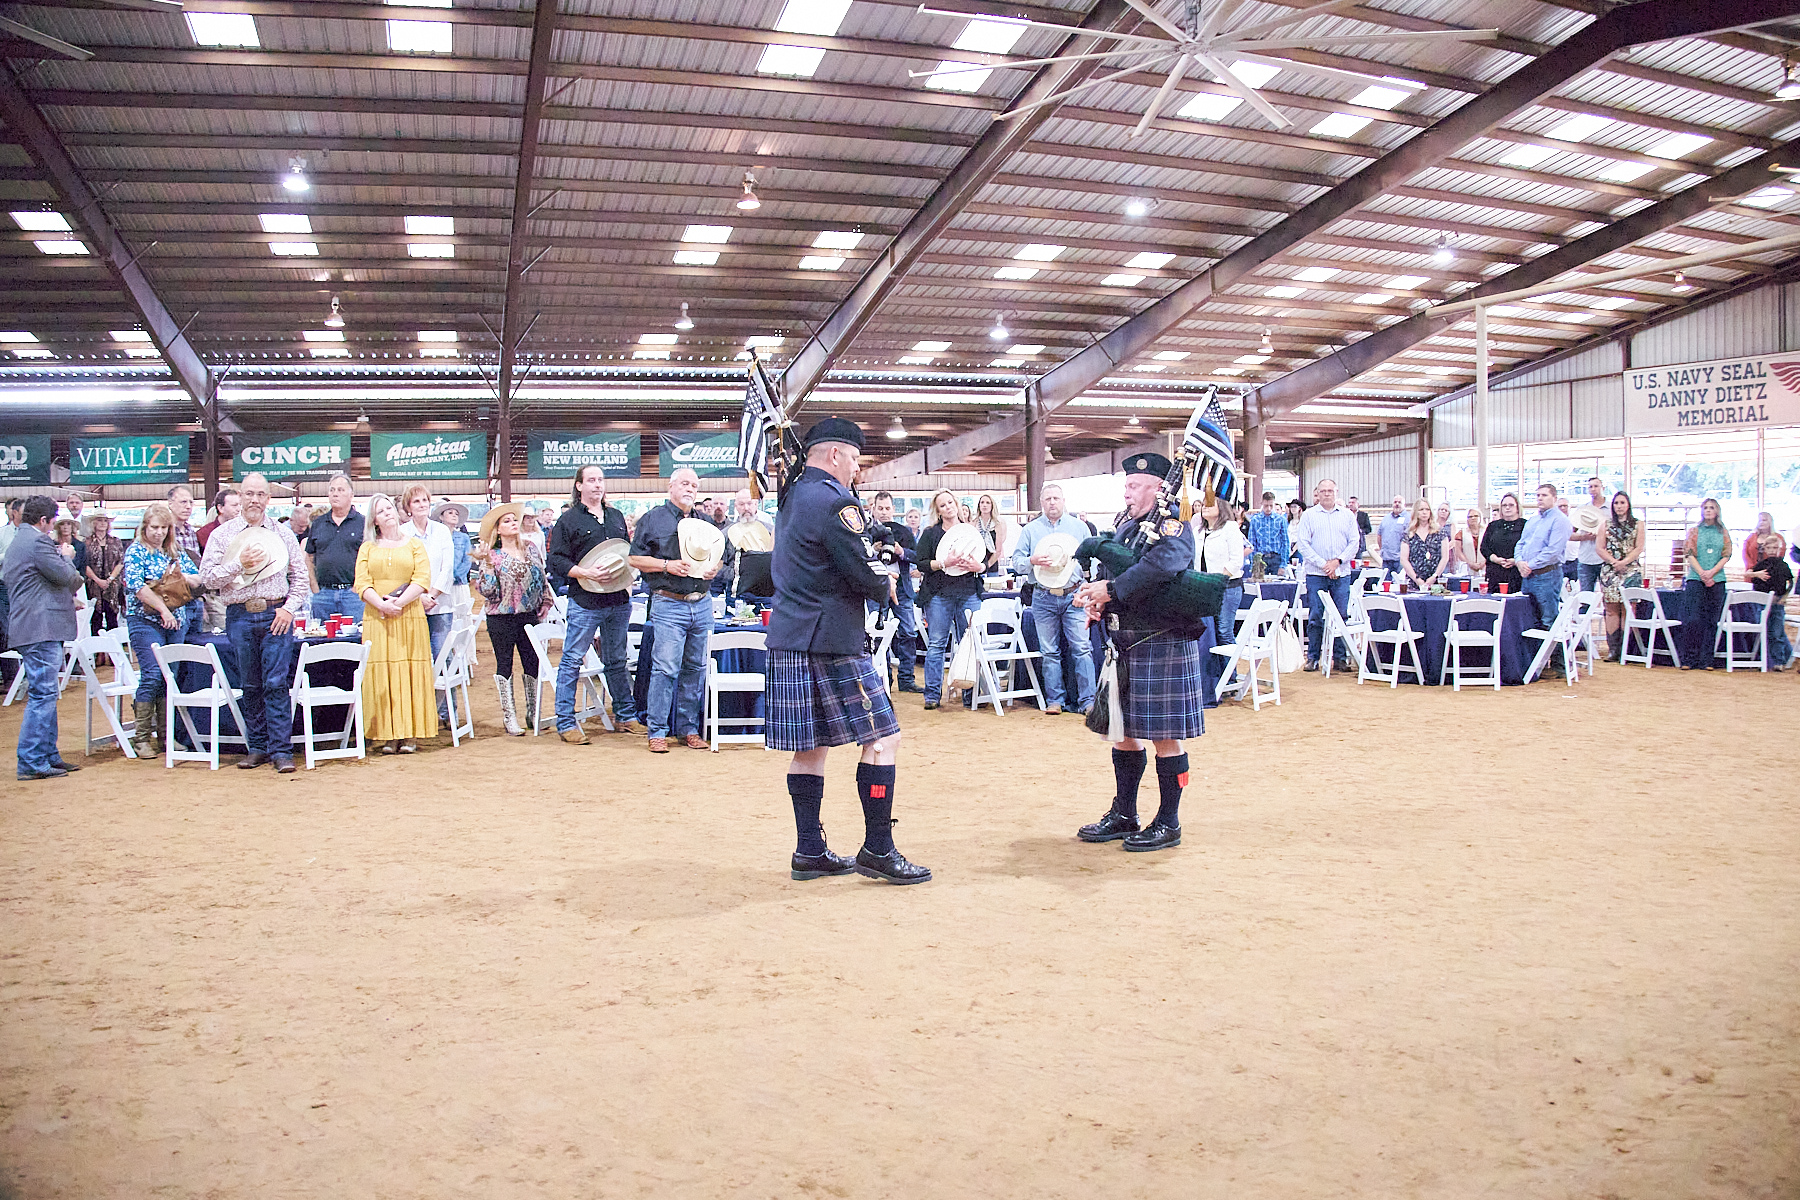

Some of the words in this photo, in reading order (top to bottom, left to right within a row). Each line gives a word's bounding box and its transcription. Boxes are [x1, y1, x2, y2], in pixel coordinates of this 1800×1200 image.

[1632, 373, 1661, 390] U.S.
[1667, 367, 1714, 387] NAVY
[1721, 361, 1767, 382] SEAL
[1648, 388, 1709, 409] DANNY
[1716, 383, 1768, 404] DIETZ
[1677, 404, 1769, 427] MEMORIAL
[241, 446, 342, 465] CINCH
[386, 439, 471, 461] American
[543, 441, 628, 452] McMaster
[393, 459, 410, 467] HAT
[410, 455, 450, 465] COMPANY,
[543, 456, 570, 465] NEW
[572, 456, 628, 465] HOLLAND
